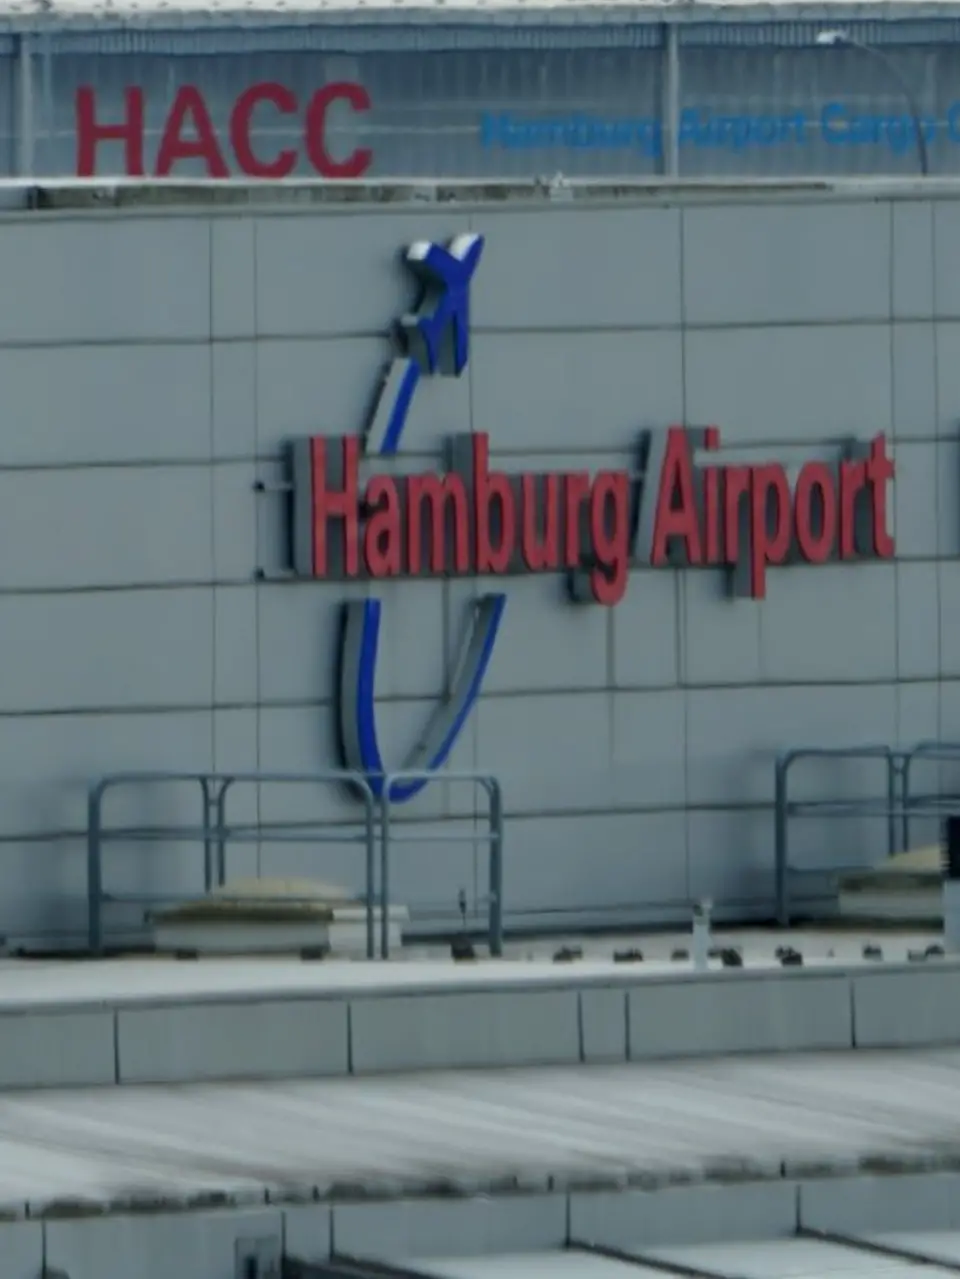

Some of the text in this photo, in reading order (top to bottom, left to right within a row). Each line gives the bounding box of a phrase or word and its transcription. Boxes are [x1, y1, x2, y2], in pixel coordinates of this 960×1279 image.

[76, 82, 372, 178] HACC
[481, 107, 662, 158] Hamburg
[681, 107, 807, 154] Airport
[822, 101, 935, 155] Cargo
[308, 426, 895, 607] Hamburg Airport
